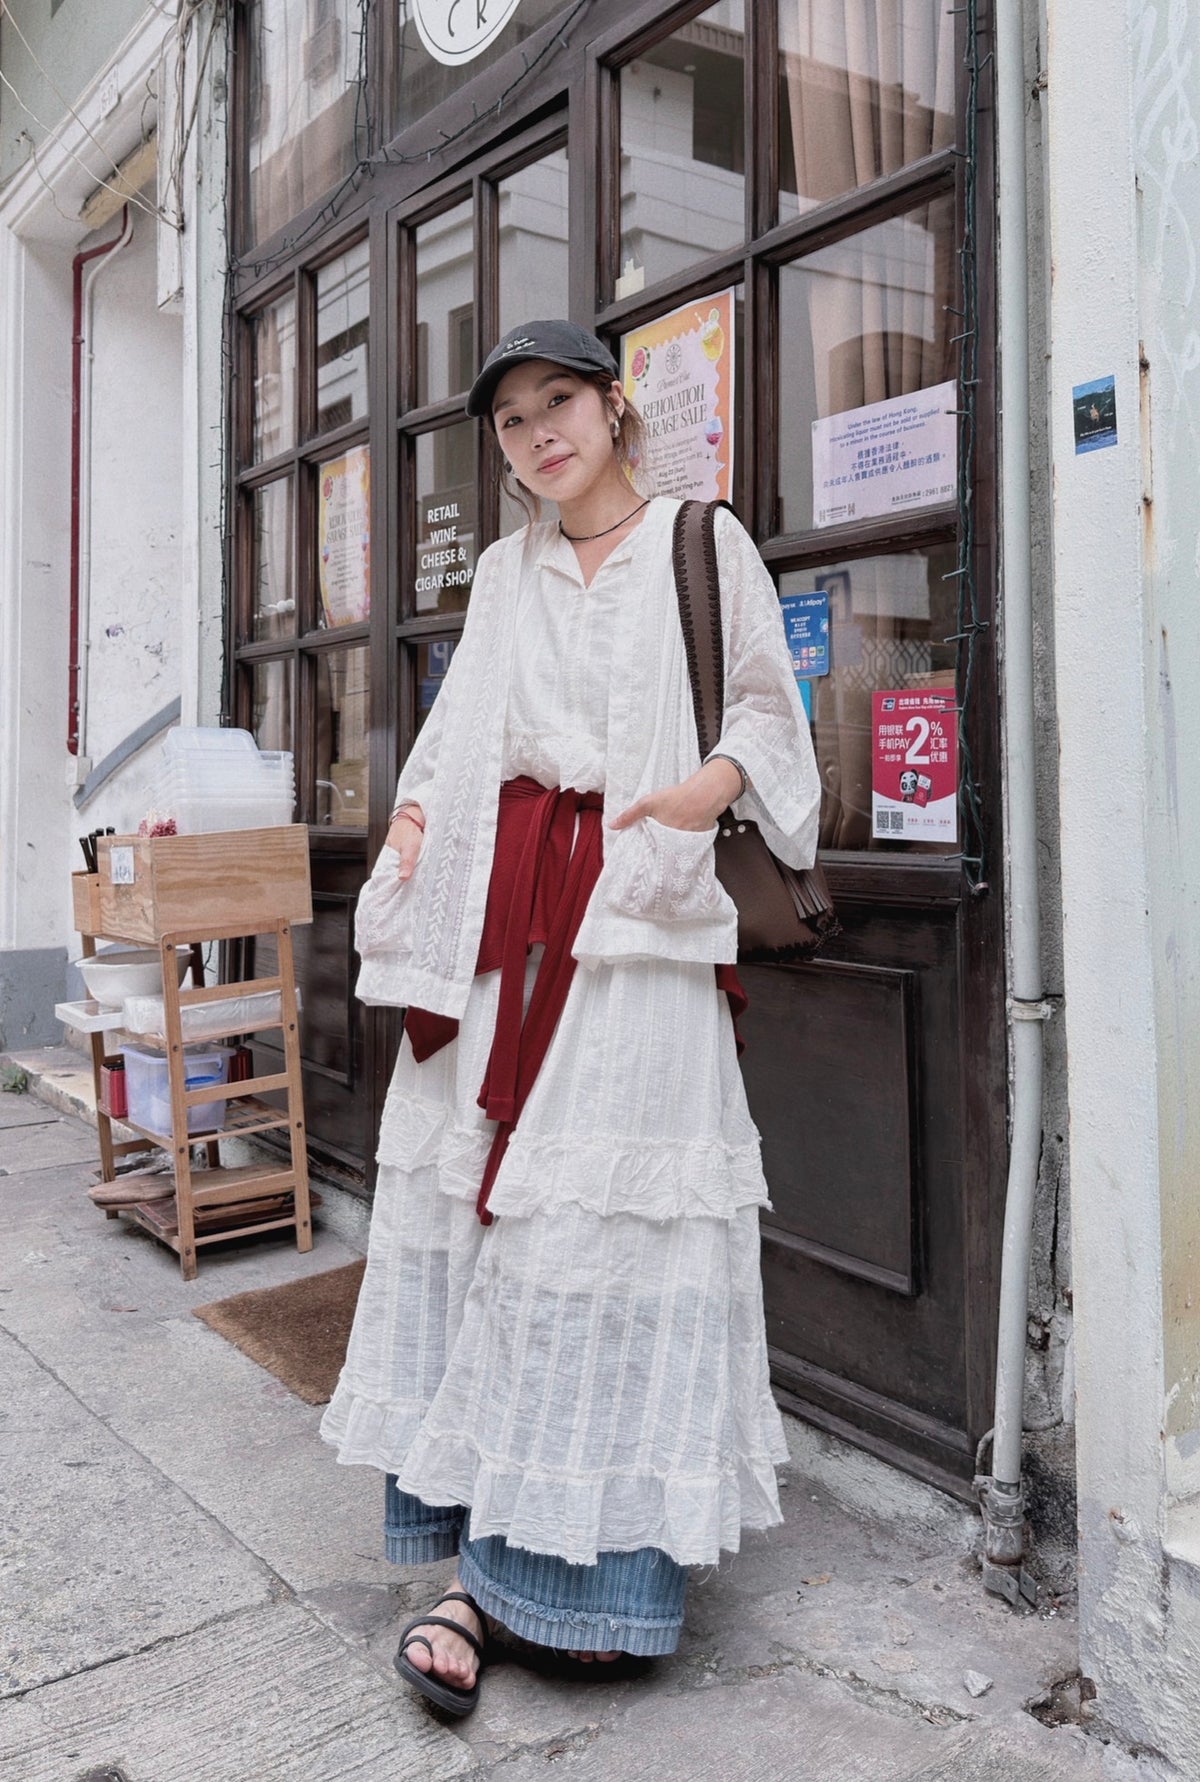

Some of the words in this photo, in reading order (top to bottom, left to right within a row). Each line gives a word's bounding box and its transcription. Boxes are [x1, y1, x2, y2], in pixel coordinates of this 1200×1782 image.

[643, 383, 704, 420] RENOVATION
[645, 413, 679, 439] ARAGE
[680, 403, 708, 428] SALE
[847, 421, 862, 430] Under
[862, 418, 871, 426] the
[882, 413, 888, 421] of
[888, 410, 902, 419] Hong
[855, 427, 869, 437] liquor
[869, 424, 882, 432] must
[900, 416, 911, 425] sold
[918, 407, 940, 420] supplied
[850, 437, 863, 445] minor
[869, 433, 878, 441] the
[879, 430, 896, 438] course
[896, 426, 903, 434] of
[427, 502, 460, 524] RETAIL
[430, 525, 457, 545] WINE
[421, 548, 456, 570] CHEESE
[457, 546, 467, 561] &
[415, 573, 445, 592] CIGAR
[445, 568, 474, 587] SHOP
[878, 724, 904, 736] 用银联
[878, 737, 911, 750] 手机PAY
[930, 737, 949, 750] 汇率
[930, 751, 949, 763] 优惠
